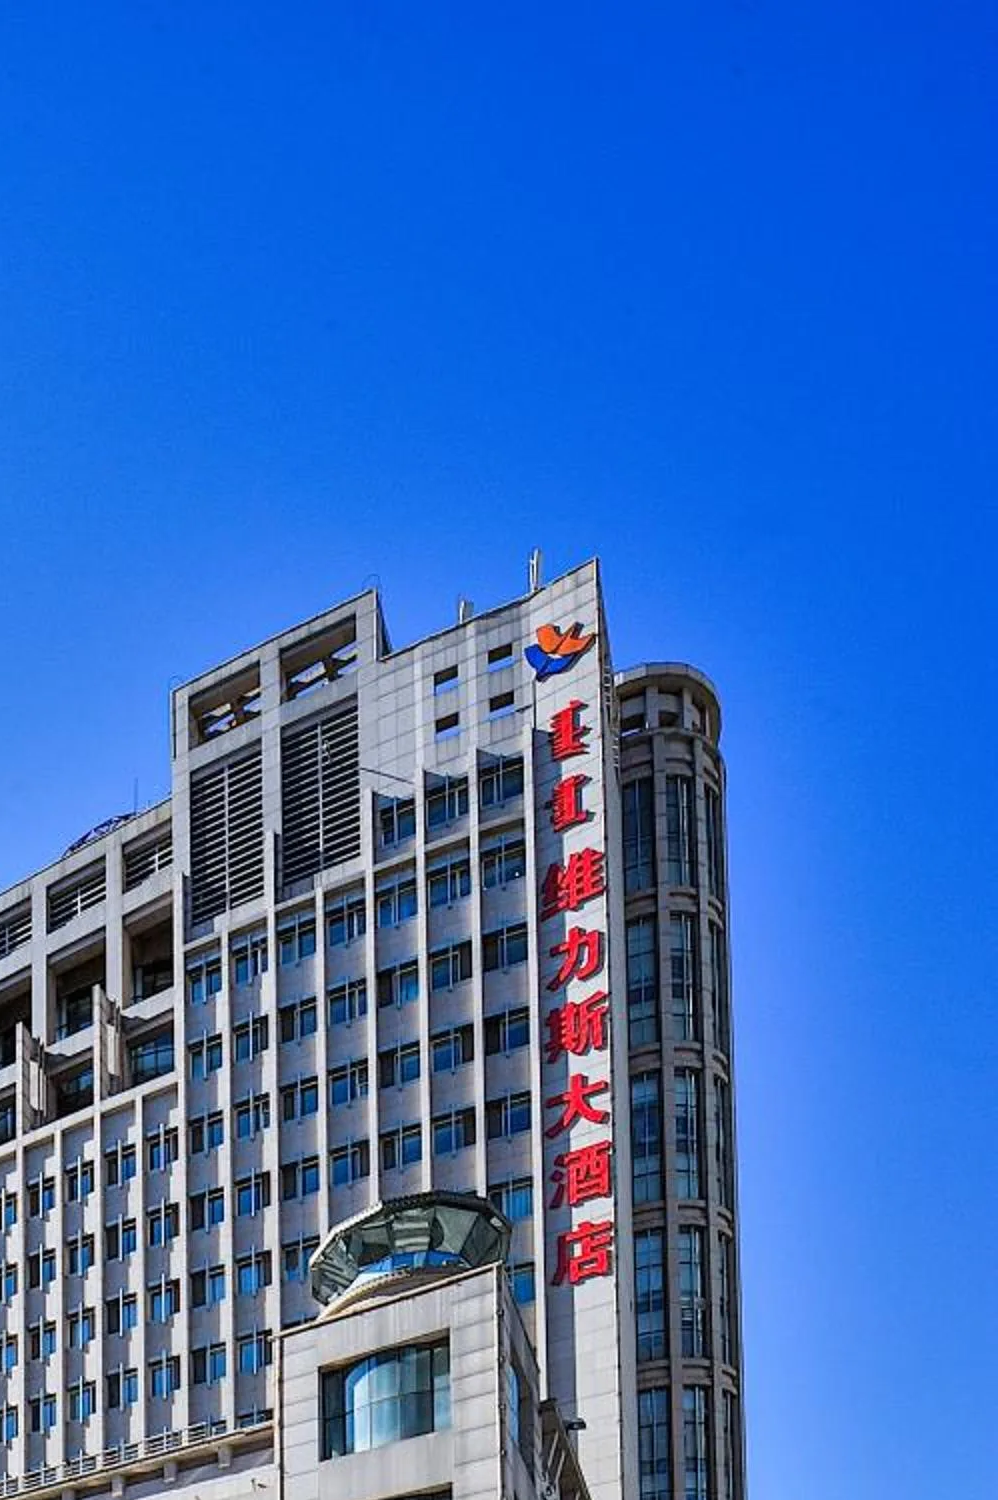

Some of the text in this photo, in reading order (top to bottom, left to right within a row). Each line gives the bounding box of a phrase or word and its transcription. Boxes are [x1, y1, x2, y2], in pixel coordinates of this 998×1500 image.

[541, 847, 613, 1287] 维力斯大酒店
